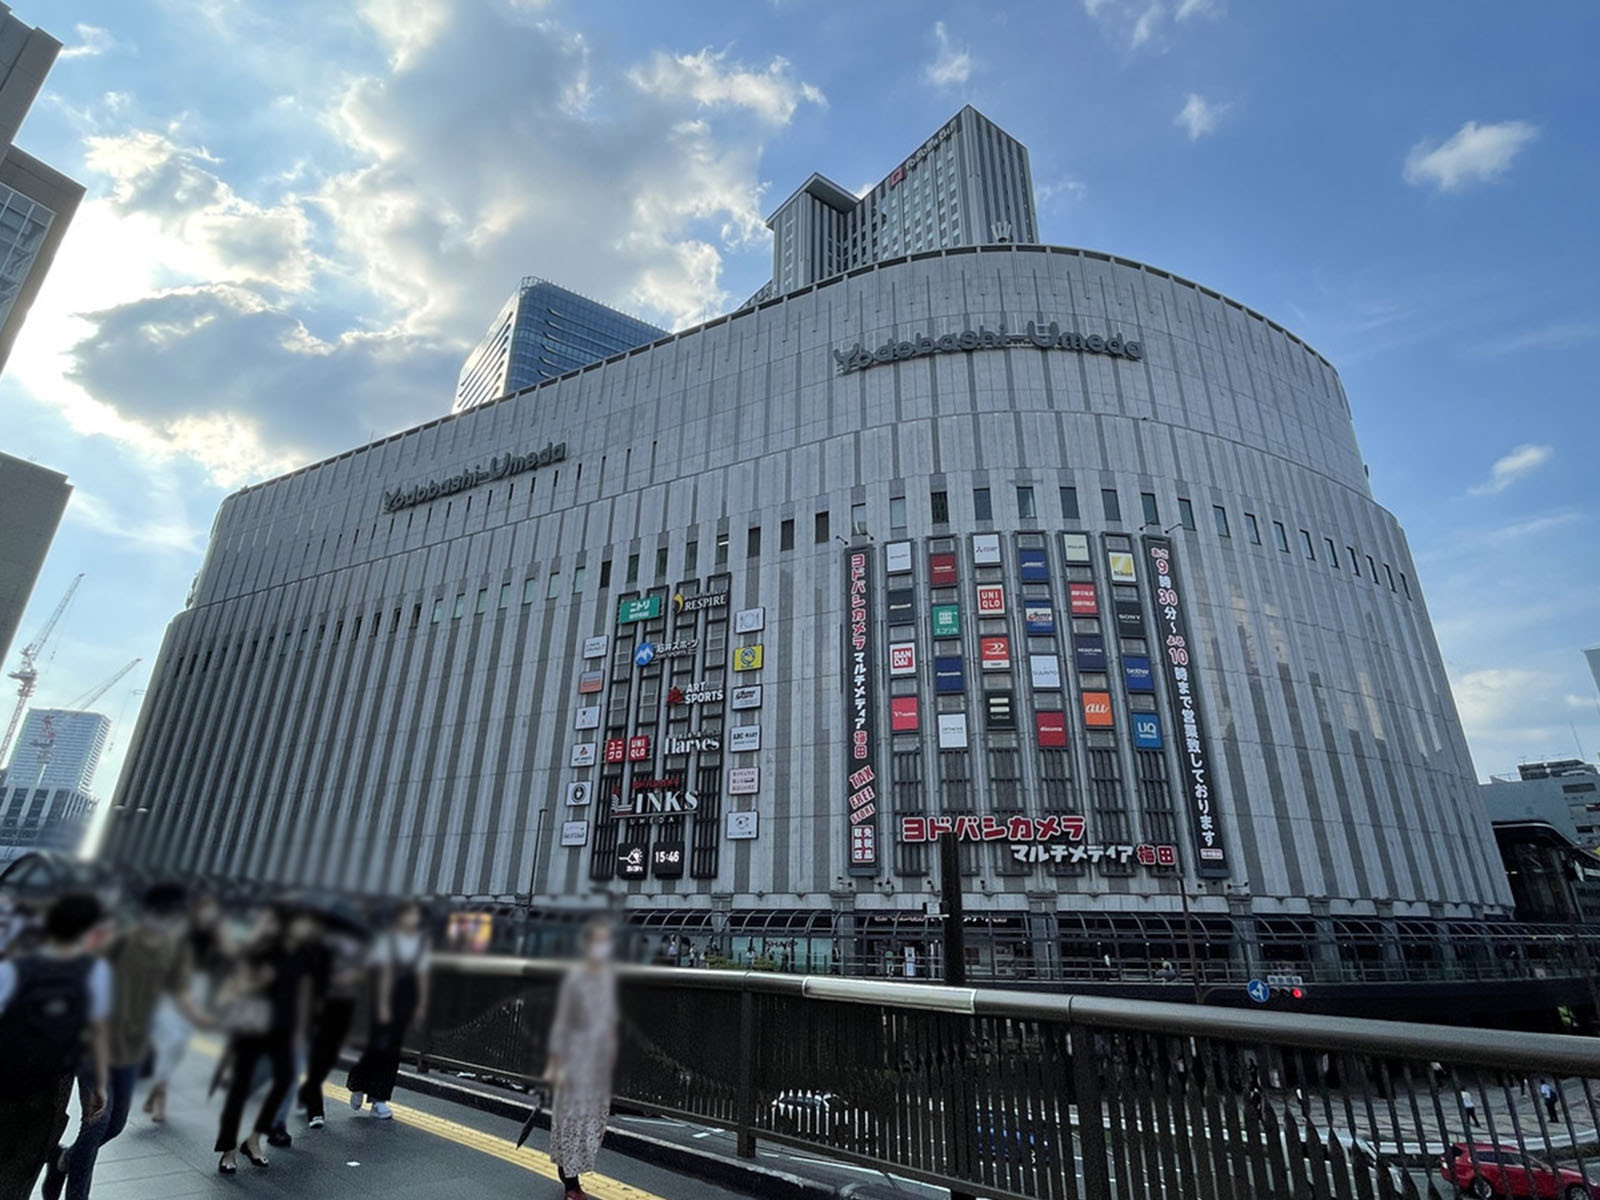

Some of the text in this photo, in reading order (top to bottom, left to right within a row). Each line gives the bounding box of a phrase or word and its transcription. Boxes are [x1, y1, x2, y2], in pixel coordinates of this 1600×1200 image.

[684, 594, 727, 611] RESPIRE
[685, 681, 706, 693] ART
[684, 690, 724, 704] SPORTS
[1085, 703, 1110, 714] au
[849, 765, 875, 789] TAX
[849, 786, 875, 810] FREE
[902, 815, 1086, 843] ヨドバシカメラ
